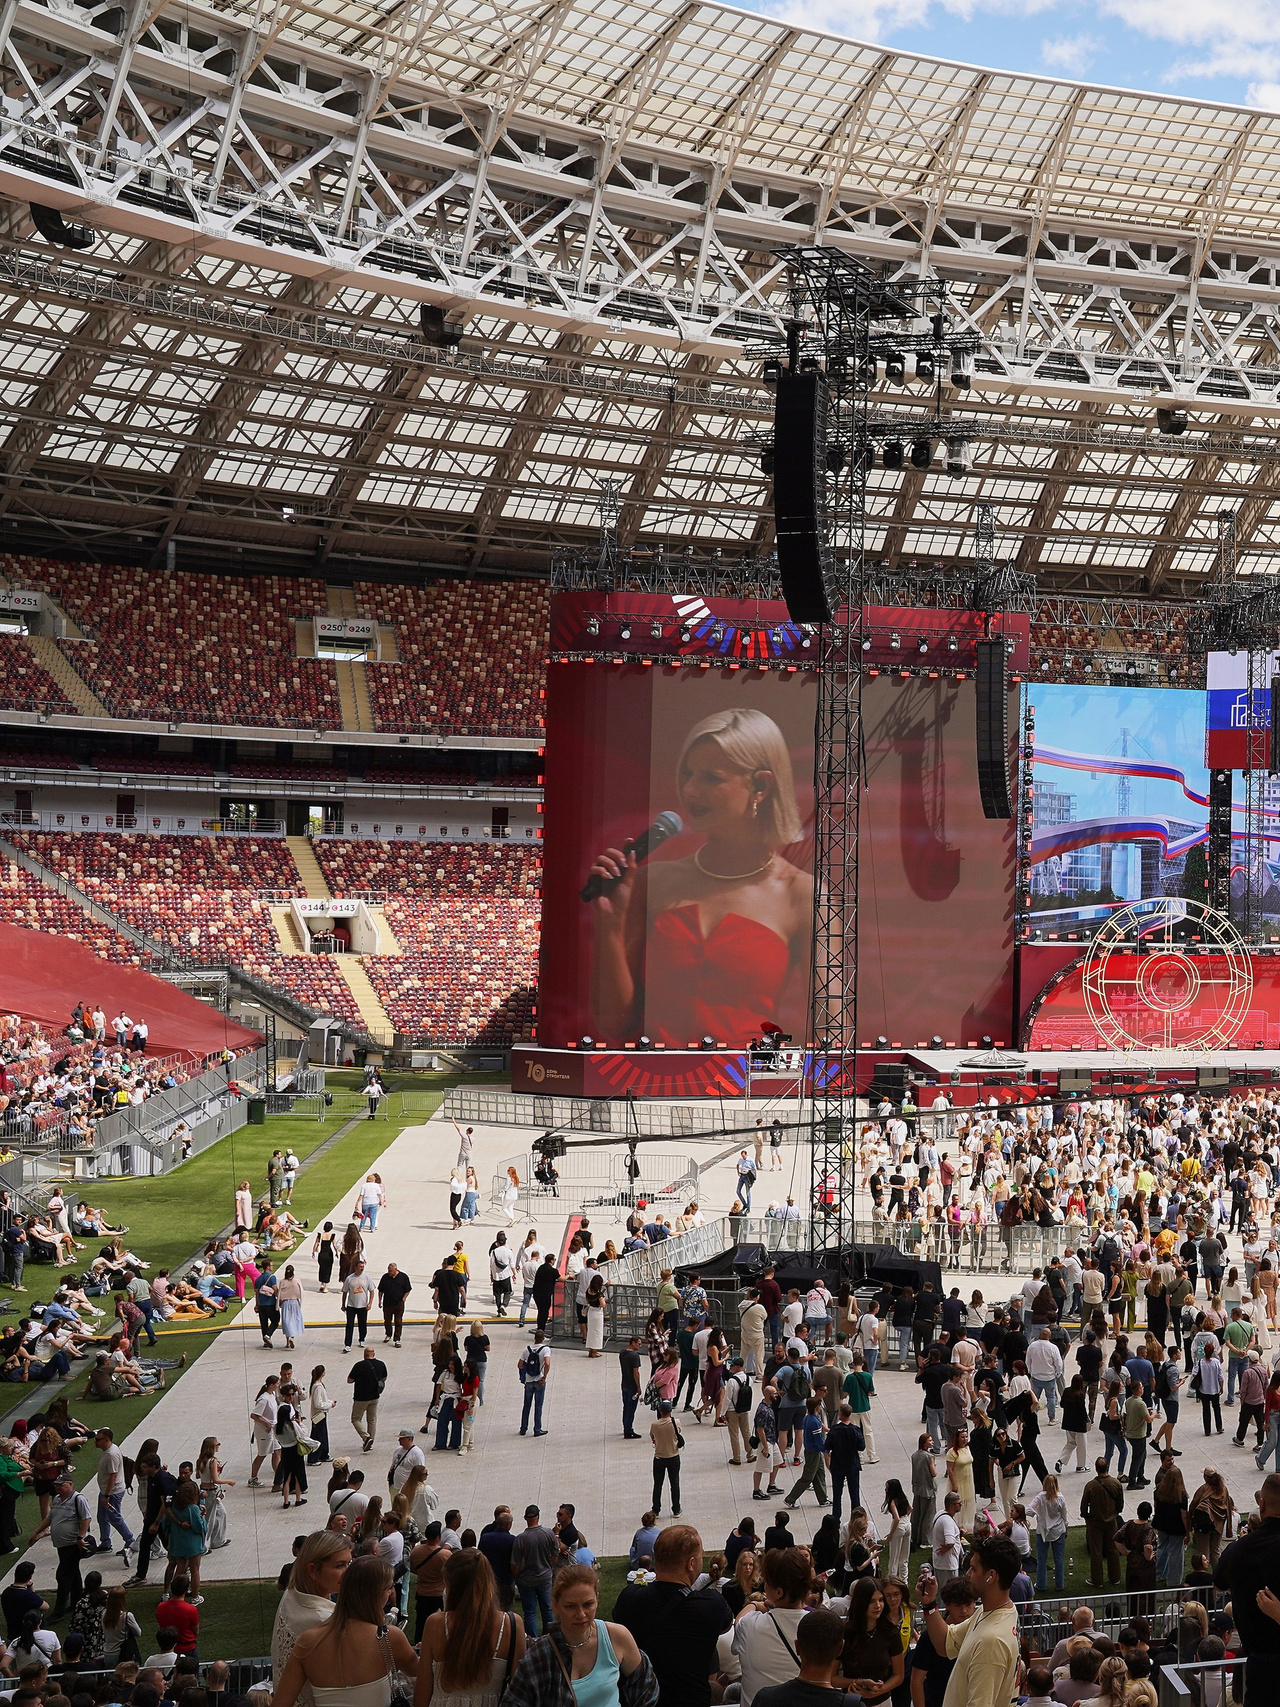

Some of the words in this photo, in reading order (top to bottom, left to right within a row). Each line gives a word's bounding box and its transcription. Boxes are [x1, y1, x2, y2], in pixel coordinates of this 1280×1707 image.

[21, 597, 38, 606] 251
[326, 624, 343, 632] 250
[308, 903, 325, 911] 144
[339, 904, 356, 912] 143
